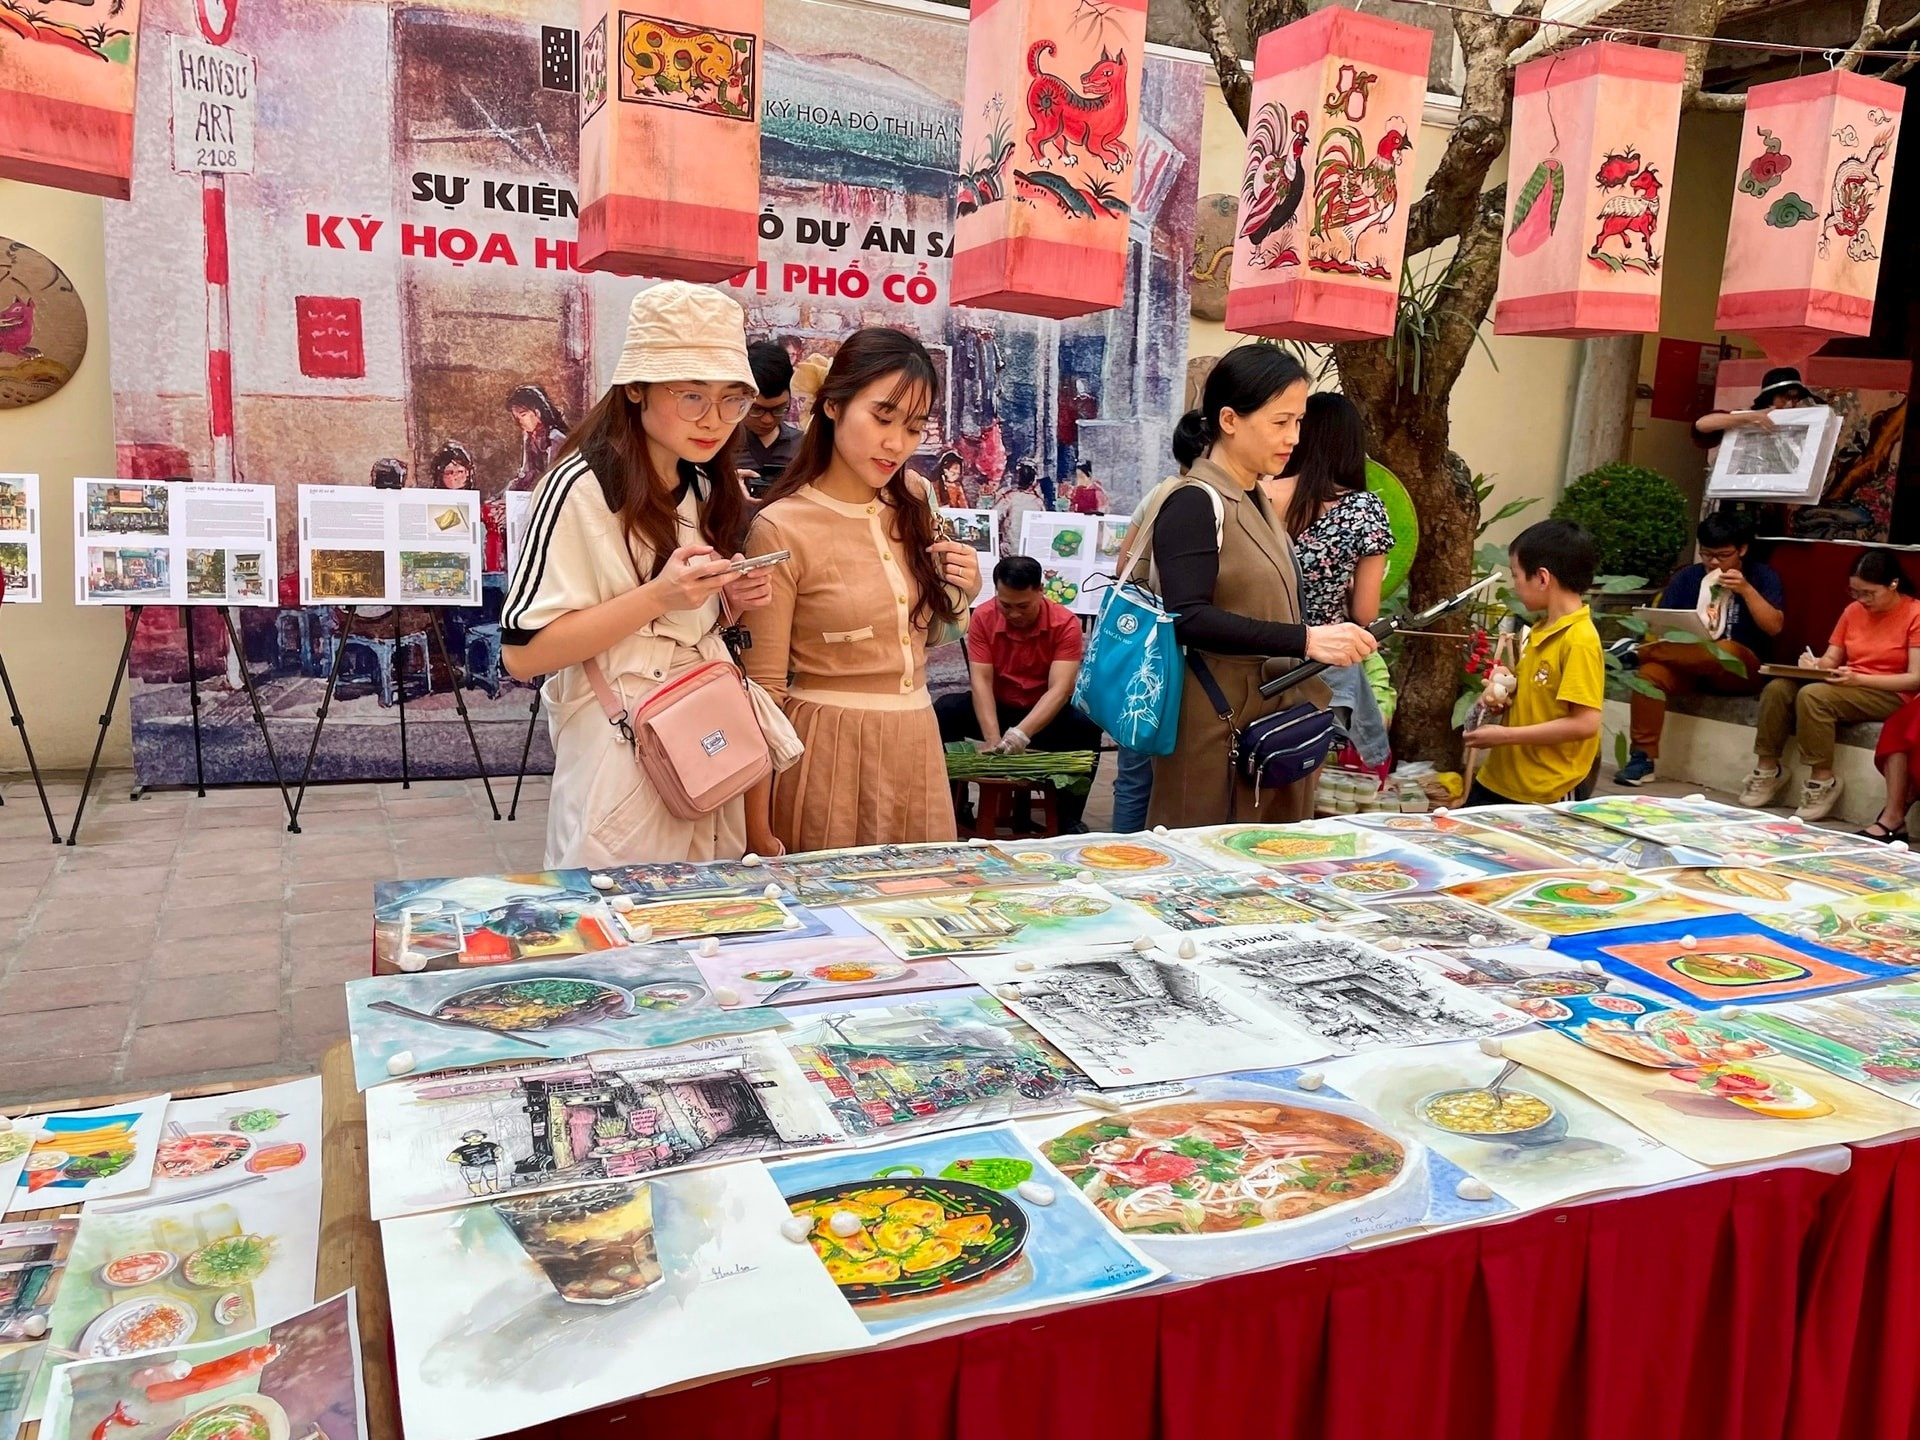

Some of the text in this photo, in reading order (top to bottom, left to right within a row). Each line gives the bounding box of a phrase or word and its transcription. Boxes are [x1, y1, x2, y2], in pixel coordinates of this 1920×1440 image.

[179, 49, 247, 99] HANSU
[195, 101, 235, 144] ART
[766, 99, 791, 118] KÝ
[797, 104, 843, 128] HỌA
[849, 111, 879, 132] ĐÔ
[884, 117, 914, 140] THỊ
[920, 122, 948, 142] HÀ
[196, 148, 237, 167] 2108
[411, 172, 470, 210] SỰ
[483, 181, 579, 221] KIỆN
[796, 217, 850, 252] DỰ
[861, 221, 916, 255] ÁN
[306, 213, 384, 252] KÝ
[401, 223, 519, 267] HỌA
[783, 260, 870, 299] PHỐ
[882, 262, 938, 305] CỔ
